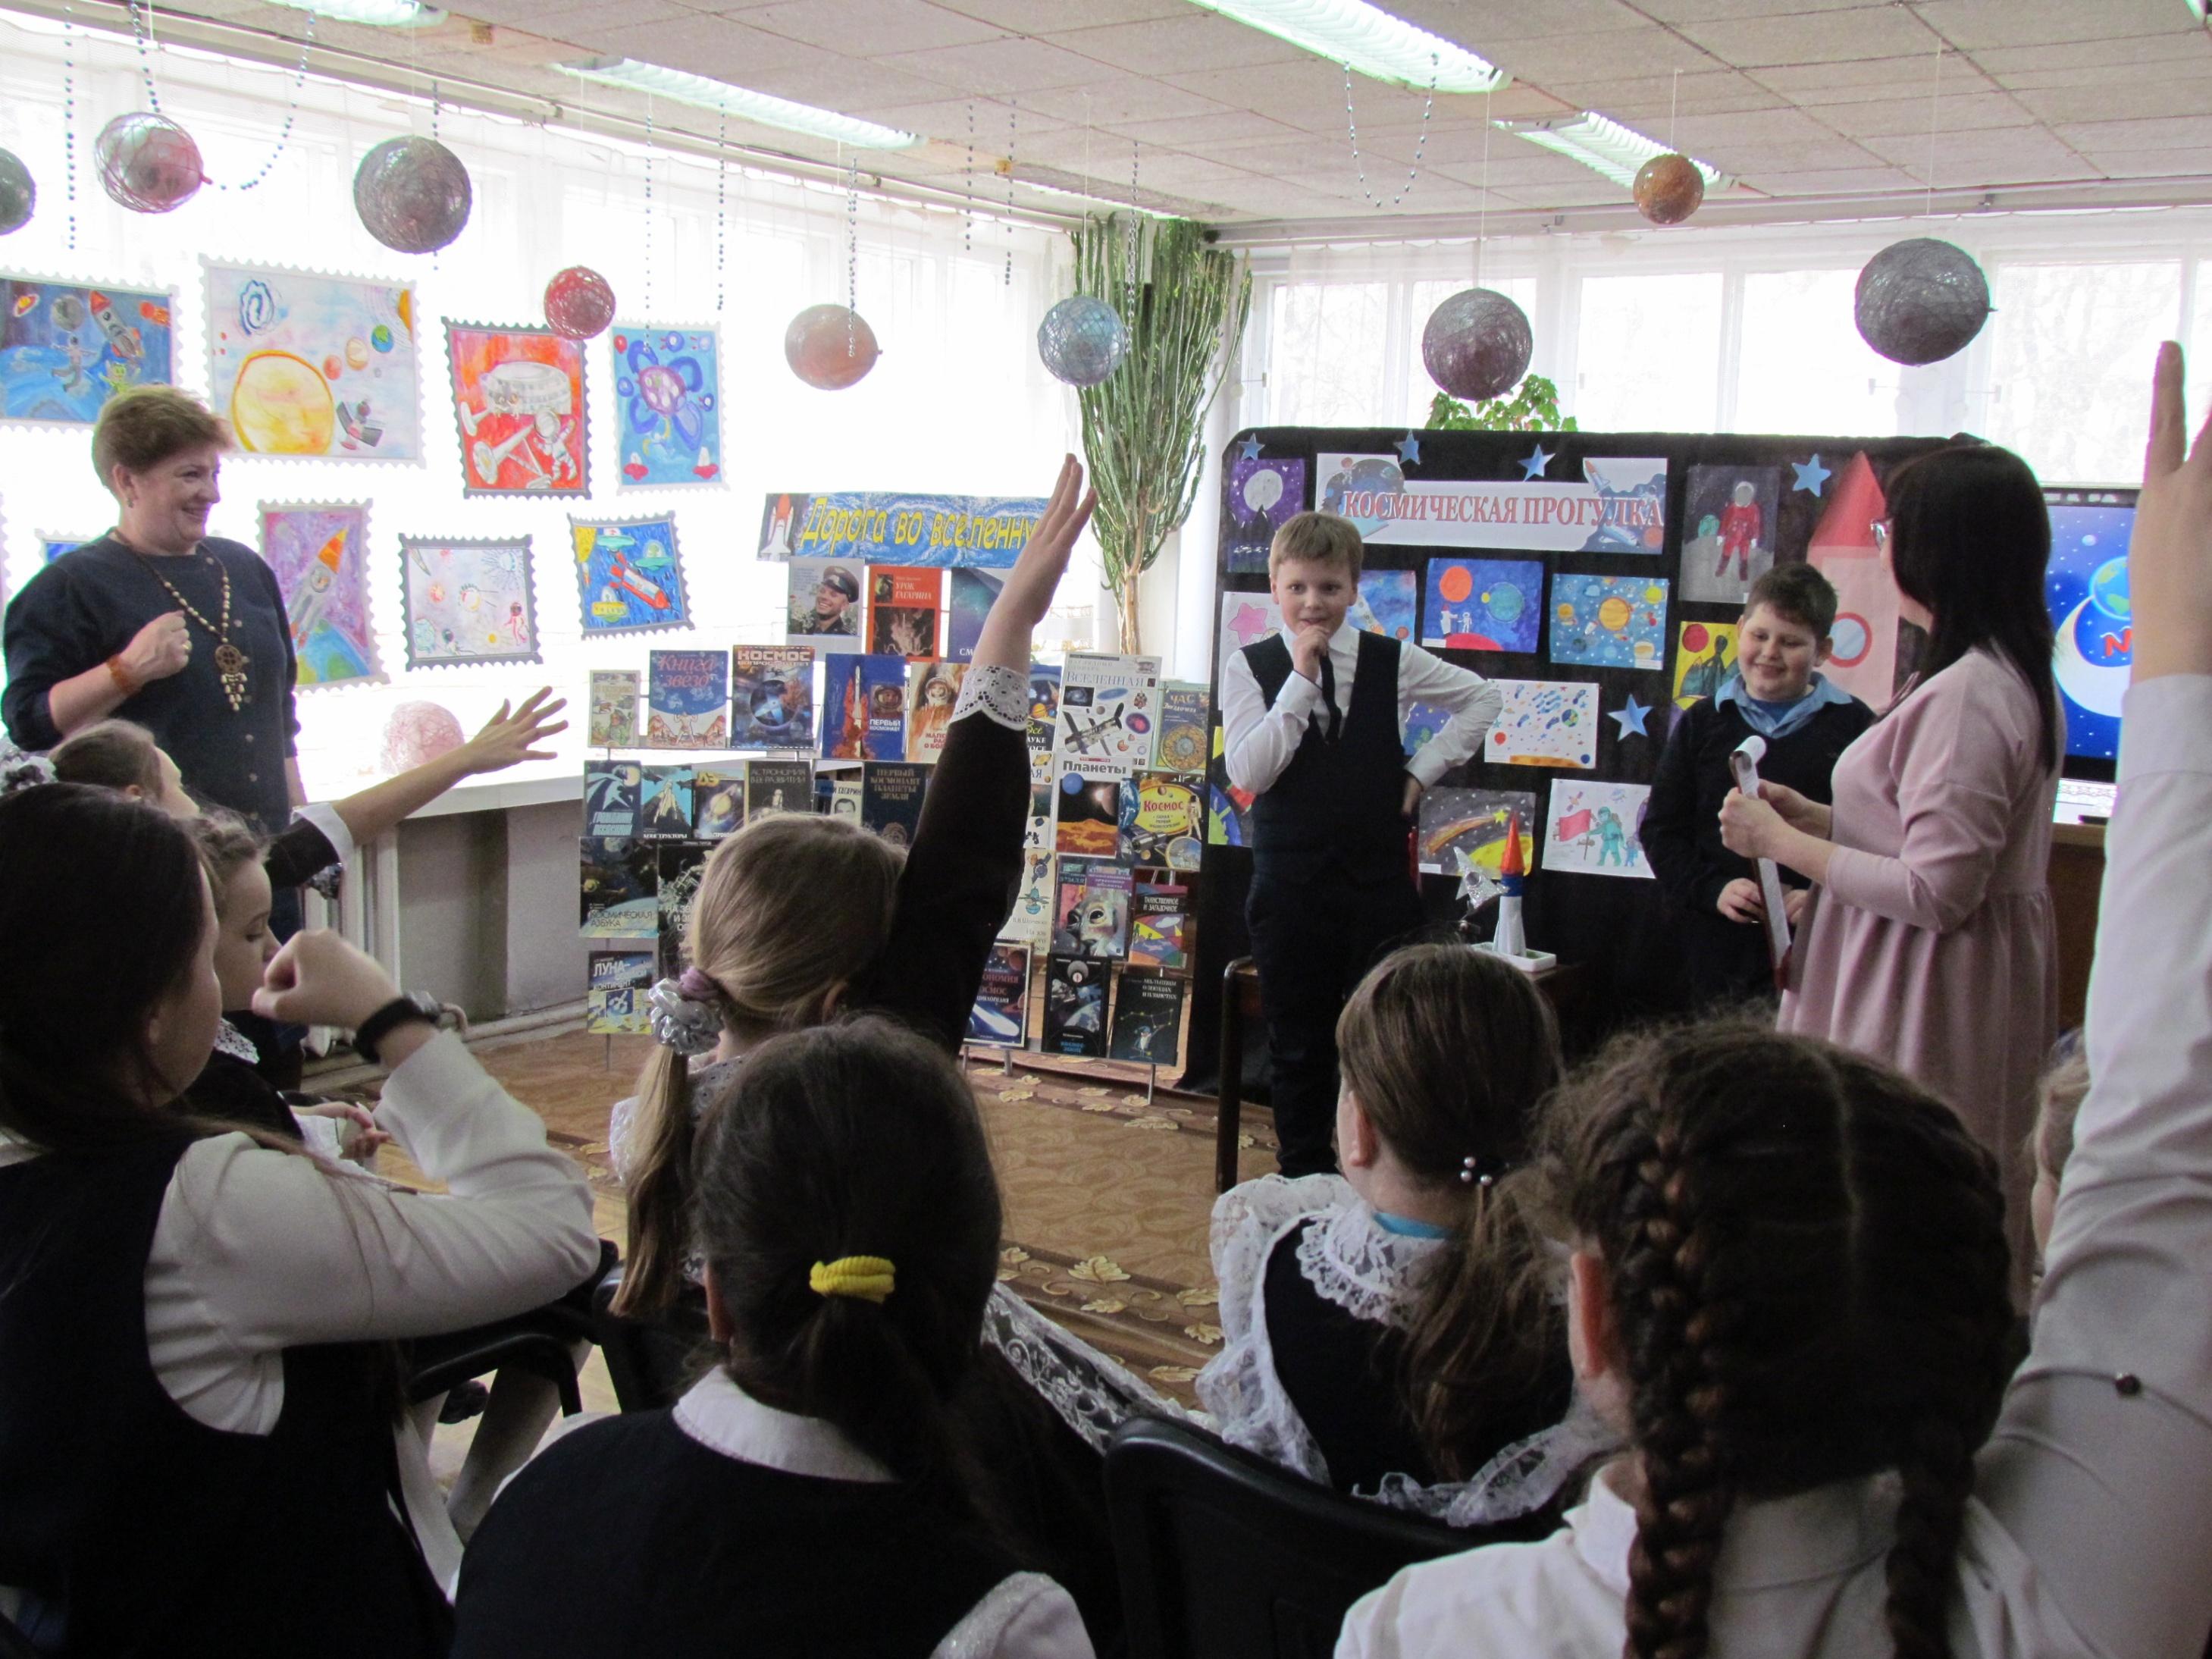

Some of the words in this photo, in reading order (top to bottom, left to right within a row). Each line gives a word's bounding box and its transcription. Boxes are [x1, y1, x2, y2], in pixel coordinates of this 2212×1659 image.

[1343, 491, 1519, 524] КОСМИЧЕСКАЯ
[1524, 495, 1664, 528] ПРОГУЛКА
[800, 497, 888, 557] Дорога
[895, 511, 923, 546] во
[930, 512, 1039, 550] вселенну
[895, 582, 916, 590] УРОК
[895, 591, 933, 600] ГАГАРИНА
[738, 649, 811, 662] КОСМОС
[959, 648, 974, 656] СМ
[658, 654, 716, 673] Книга
[876, 768, 915, 777] ПЕРВЫЙ
[1063, 760, 1126, 774] Планеты
[1143, 800, 1184, 814] Космос
[591, 919, 621, 927] АЗБУКА
[982, 973, 1019, 983] ОНОМИЯ
